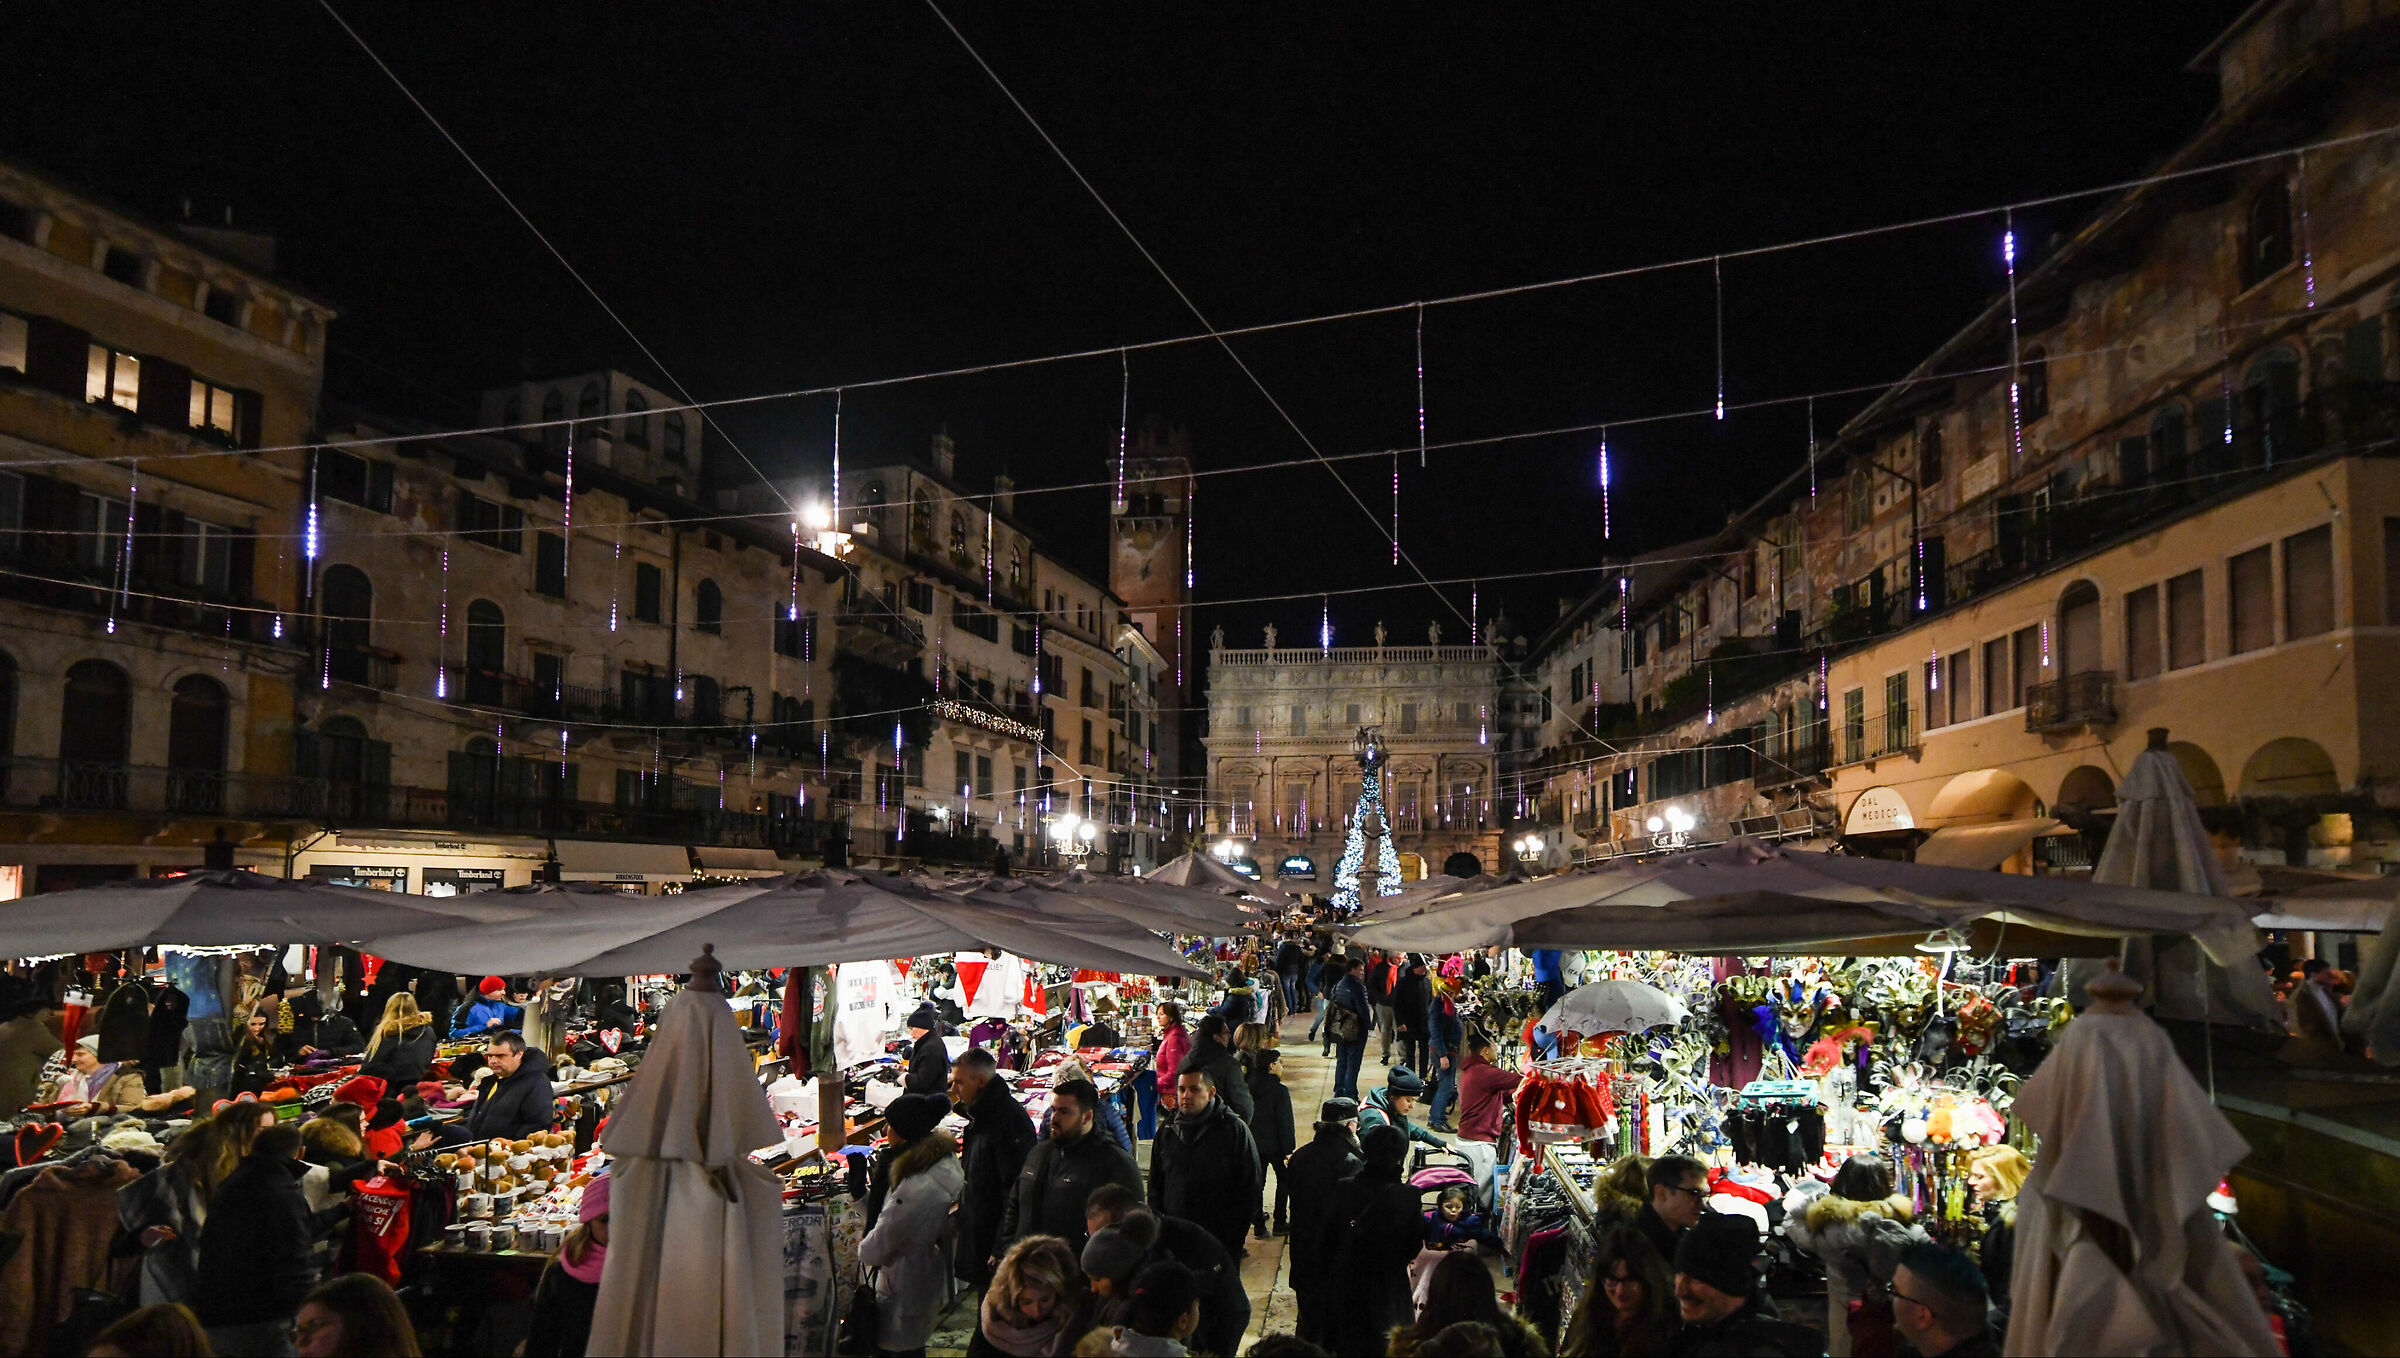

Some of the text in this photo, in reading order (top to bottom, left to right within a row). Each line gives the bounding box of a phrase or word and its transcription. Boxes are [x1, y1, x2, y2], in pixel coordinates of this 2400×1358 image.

[1862, 797, 1878, 807] DAL
[1863, 808, 1898, 820] MEDICO
[353, 867, 395, 877] Timberland
[457, 870, 493, 879] Timberland
